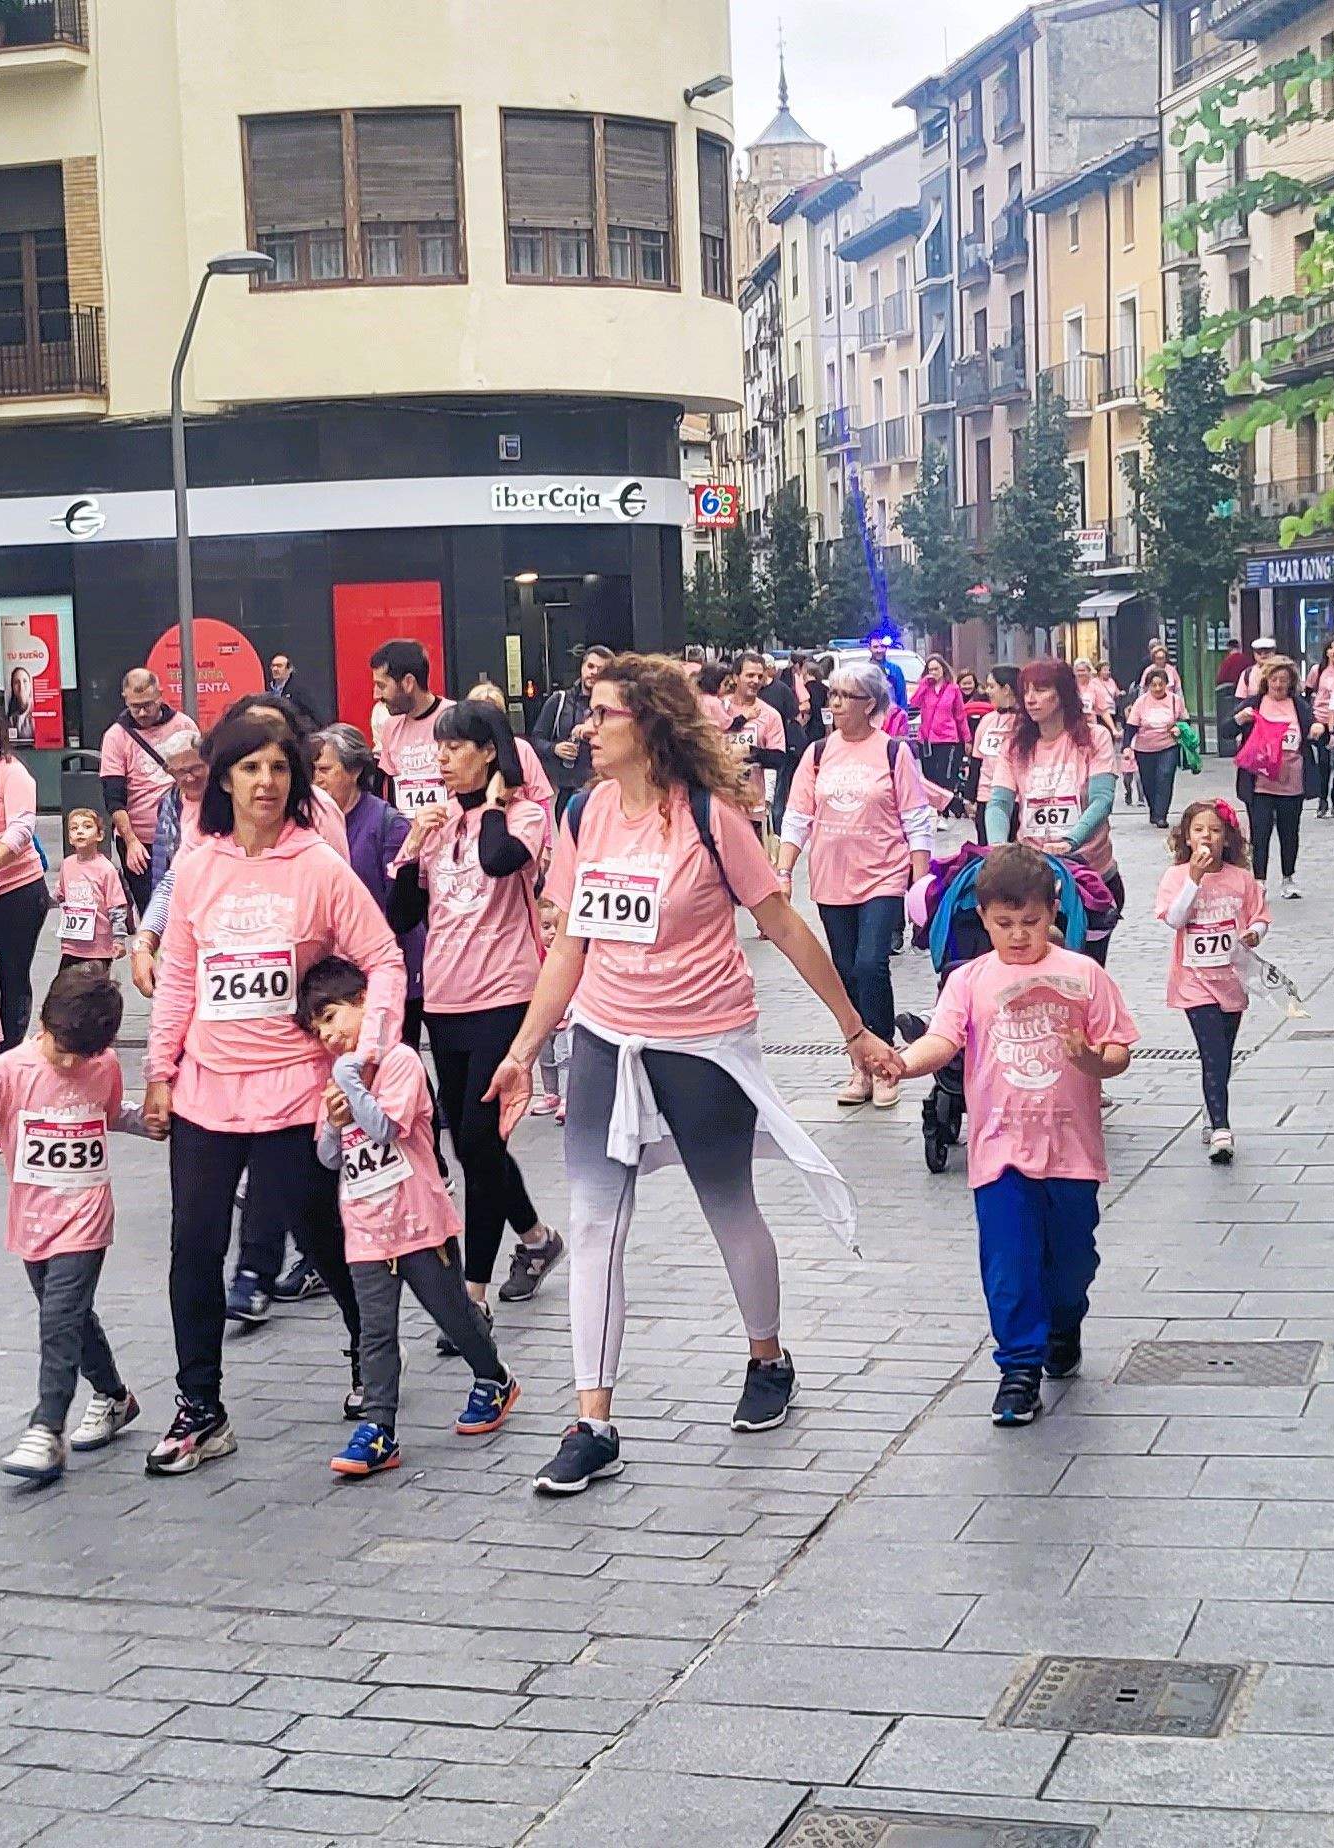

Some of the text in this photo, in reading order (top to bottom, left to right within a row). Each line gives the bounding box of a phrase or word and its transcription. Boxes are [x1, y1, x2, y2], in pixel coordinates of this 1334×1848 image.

[1268, 560, 1299, 584] BAZAR
[406, 790, 437, 808] 144
[1034, 808, 1070, 825] 667
[579, 890, 651, 923] 2190
[1194, 933, 1232, 955] 670
[210, 970, 288, 1001] 2640
[27, 1139, 104, 1168] 2639
